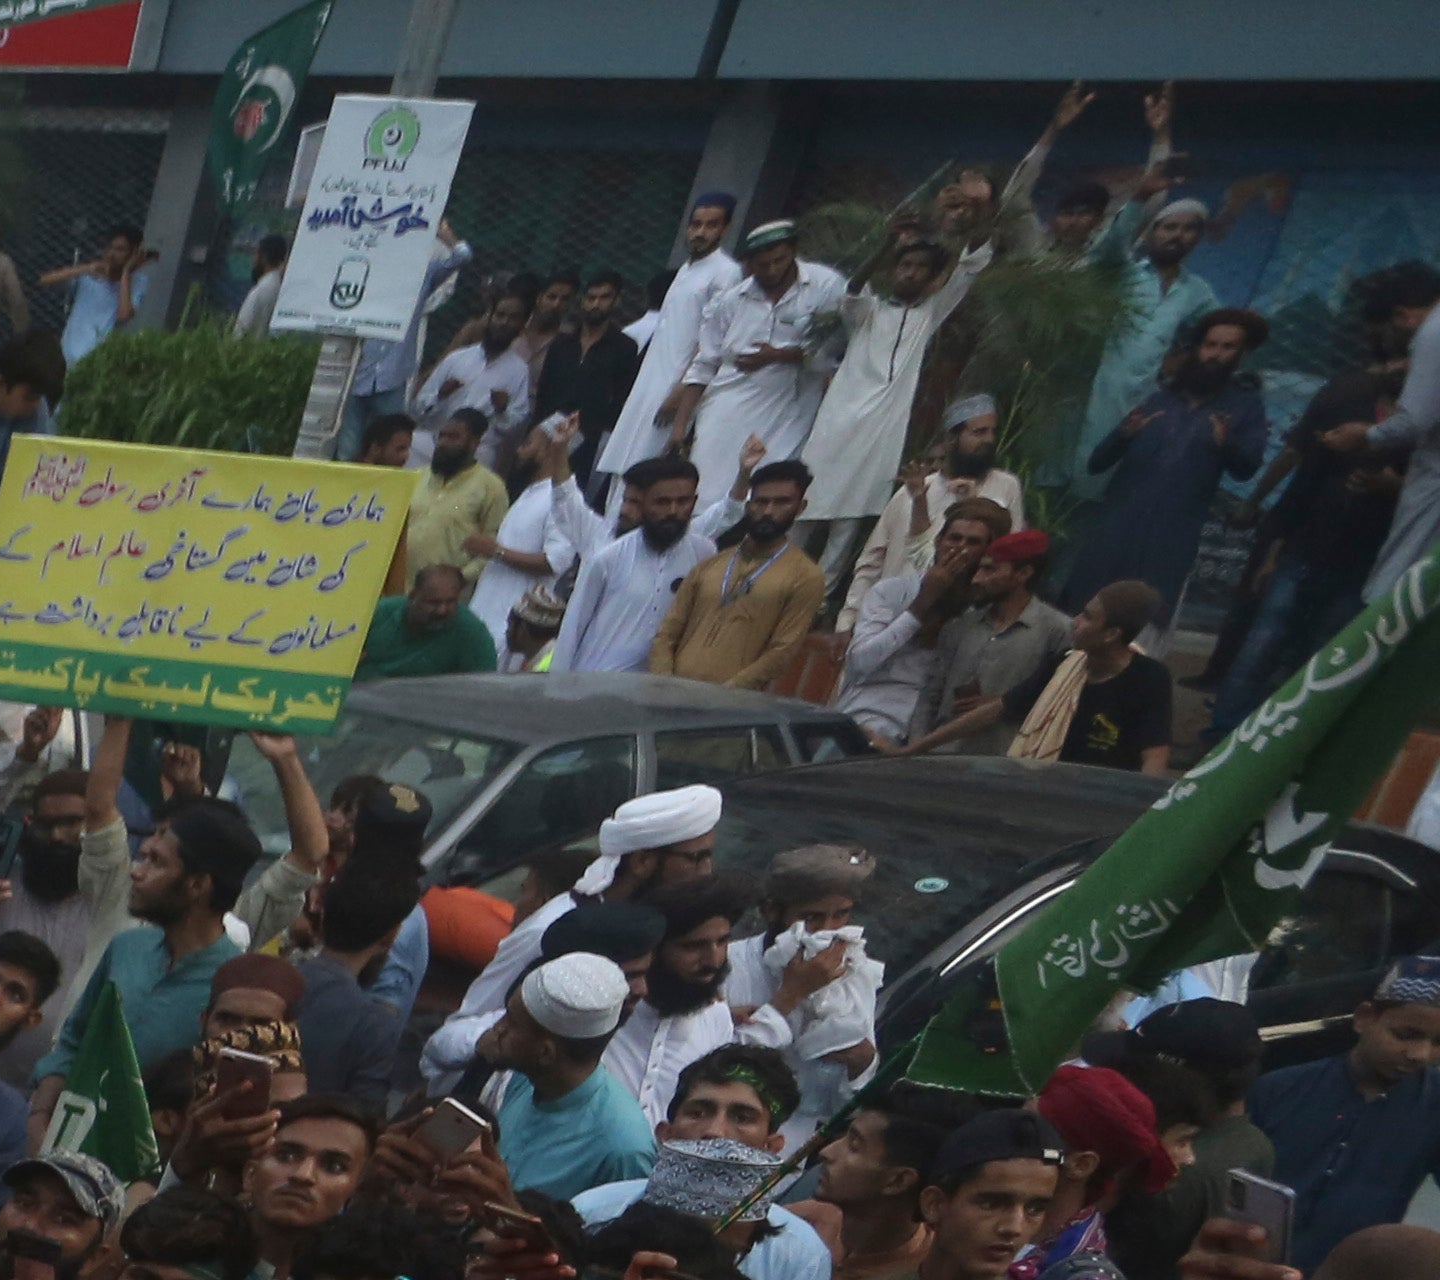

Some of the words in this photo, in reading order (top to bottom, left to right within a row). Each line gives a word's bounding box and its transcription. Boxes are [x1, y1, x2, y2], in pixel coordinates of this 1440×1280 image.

[201, 482, 274, 512] ہمارے
[321, 492, 386, 526] ہماری
[40, 532, 104, 581] اسلام
[140, 524, 251, 582] گستاخی
[223, 549, 268, 585] میں
[265, 552, 318, 589] شان
[317, 539, 370, 593] کی
[227, 606, 269, 647] کے
[266, 614, 358, 656] مسلمانوں
[103, 665, 213, 713] لبیک
[210, 676, 342, 725] تحریک
